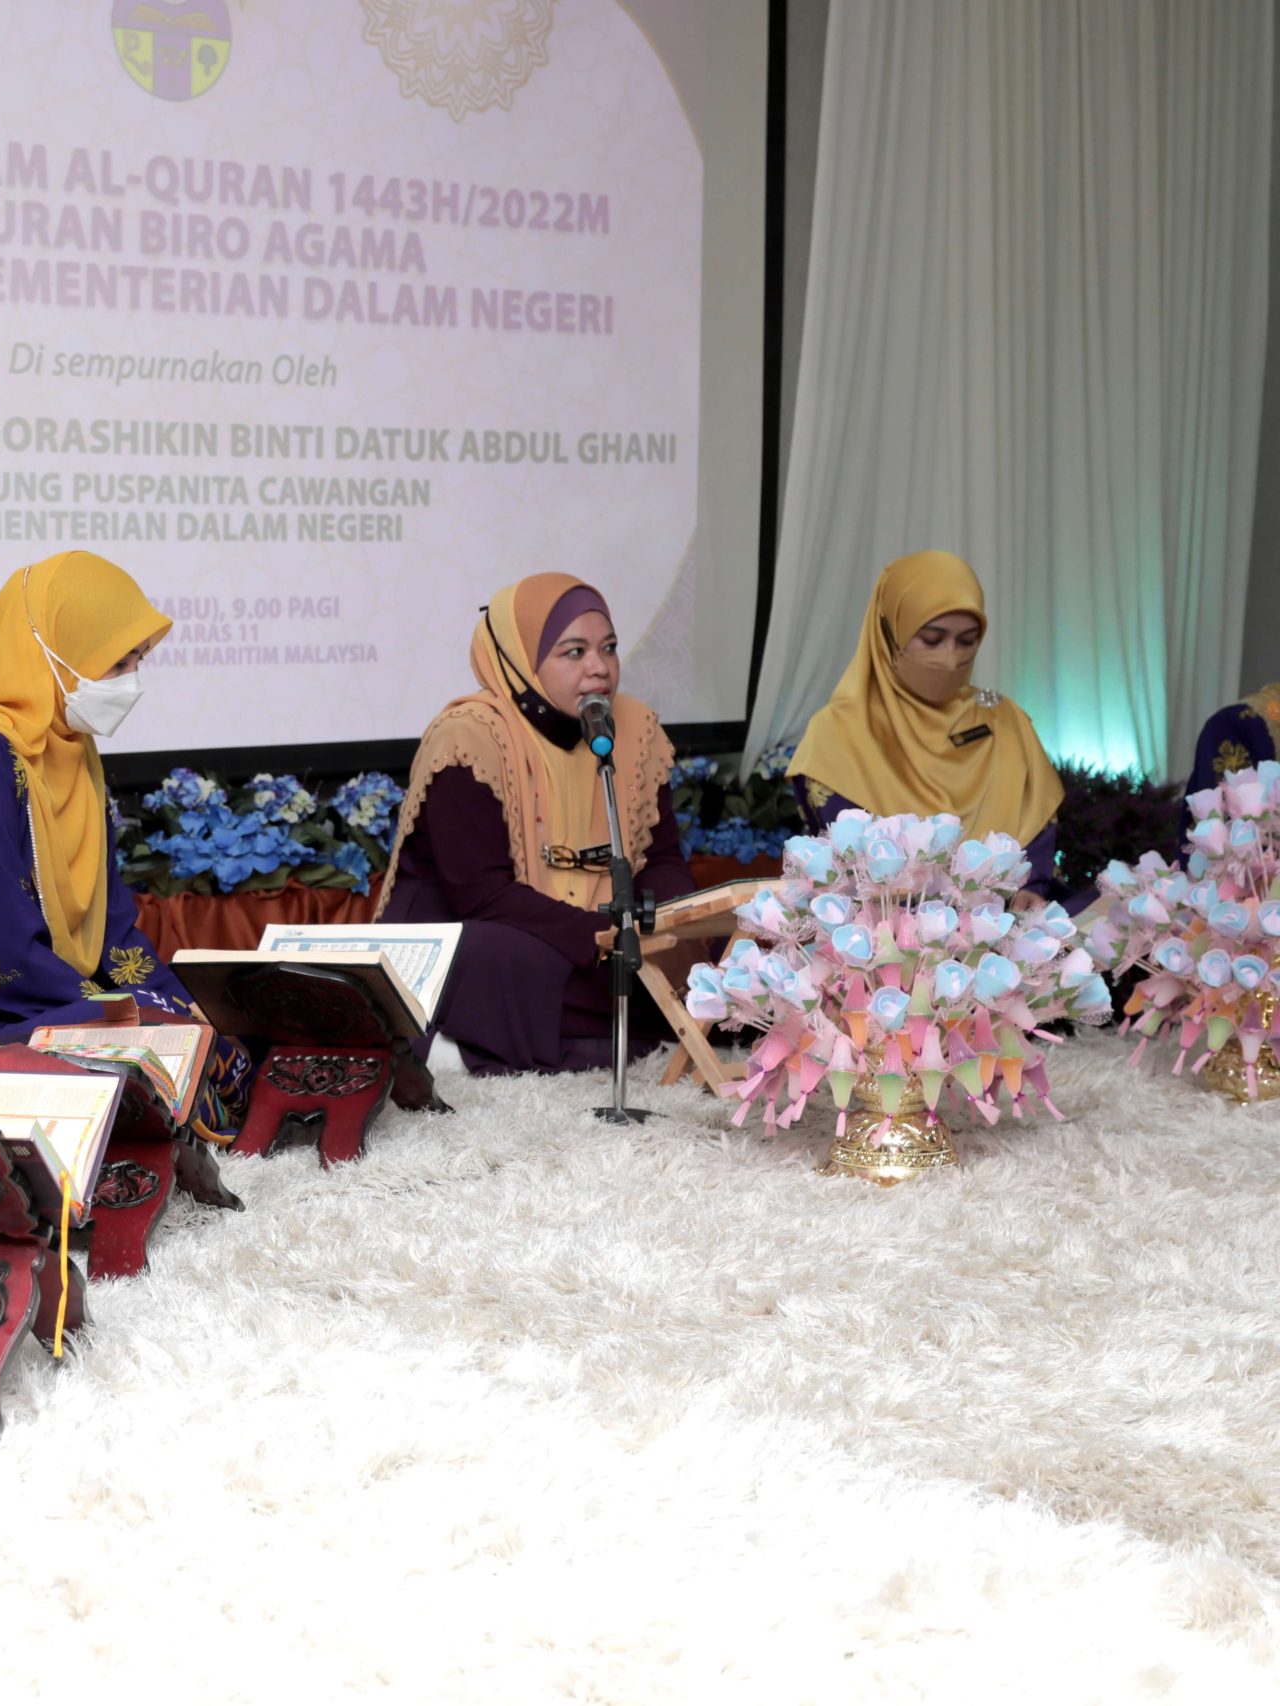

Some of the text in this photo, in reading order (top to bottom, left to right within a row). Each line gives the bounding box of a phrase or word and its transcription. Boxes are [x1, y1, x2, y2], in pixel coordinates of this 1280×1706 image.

[64, 148, 312, 212] AL-QURAN
[329, 173, 609, 234] 1443H/2022M
[140, 210, 250, 261] BIRO
[263, 221, 427, 274] AGAMA
[304, 277, 457, 327] DALAM
[472, 289, 613, 334] NEGERI
[9, 342, 337, 387] Di sempurnakan Oleh
[231, 424, 323, 459] BINTI
[336, 427, 450, 461] DATUK
[459, 430, 568, 463] ABDUL
[577, 432, 676, 464] GHANI
[73, 473, 249, 505] PUSPANITA
[258, 477, 430, 506] CAWANGAN
[177, 512, 287, 541] DALAM
[297, 513, 403, 542] NEGERI
[148, 596, 226, 622] ABU),
[232, 596, 282, 620] 9.00
[287, 595, 341, 618] PAGI
[180, 622, 233, 644] ARAS
[239, 622, 260, 642] 11
[193, 645, 277, 667] MARITIM
[283, 643, 381, 665] MALAYSIA
